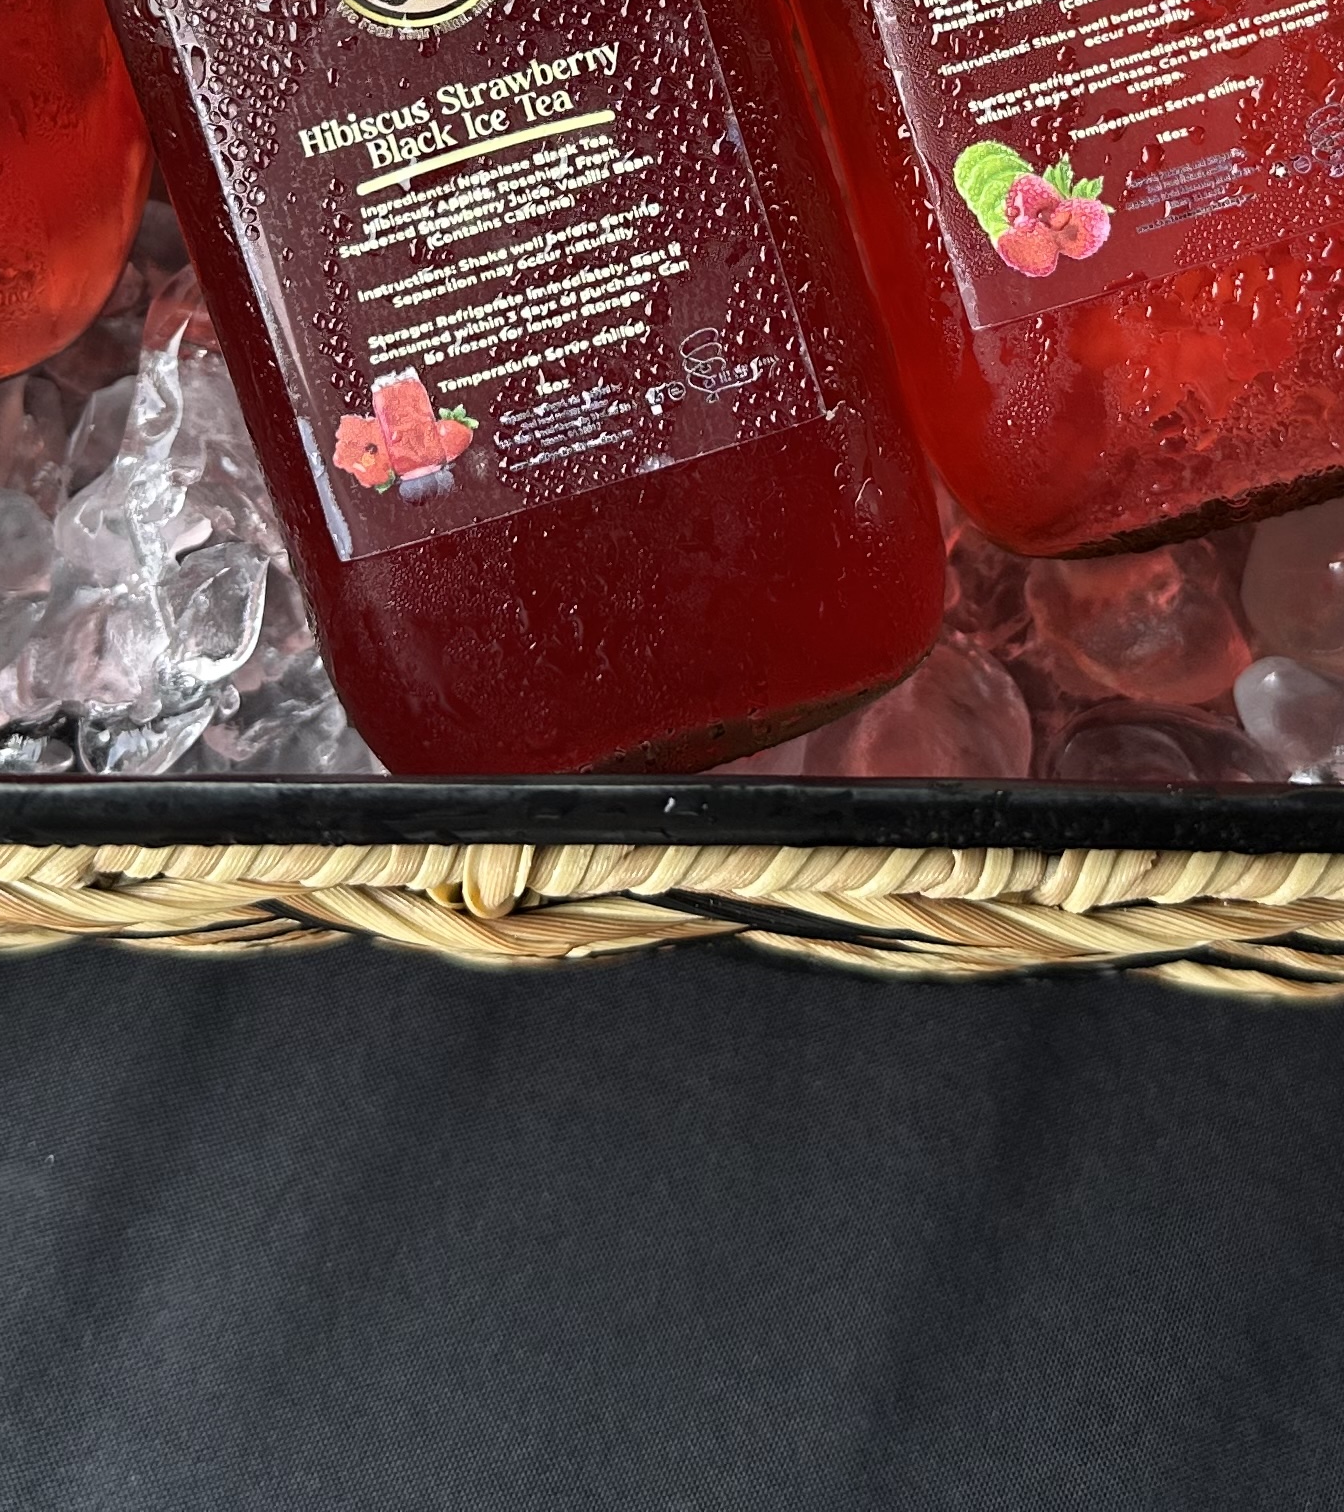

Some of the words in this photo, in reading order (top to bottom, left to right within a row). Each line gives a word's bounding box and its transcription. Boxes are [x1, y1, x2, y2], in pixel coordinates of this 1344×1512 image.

[933, 6, 1005, 37] Raspberry
[1084, 28, 1124, 47] occur
[1127, 8, 1194, 34] naturally.
[975, 105, 1021, 125] within
[1022, 100, 1033, 112] 3
[1034, 90, 1069, 108] days
[1070, 83, 1085, 97] of
[1158, 54, 1188, 69] Can
[1189, 48, 1209, 60] be
[1259, 25, 1281, 39] for
[1281, 10, 1329, 33] longer
[1127, 71, 1185, 94] storage.
[299, 99, 429, 157] Hibiscus
[437, 43, 618, 118] Strawberry
[366, 121, 456, 168] Black
[461, 108, 509, 139] Ice
[514, 84, 573, 121] Tea
[1069, 106, 1163, 141] Temperature:
[1164, 93, 1206, 112] Serve
[457, 160, 530, 189] Nepalese
[578, 134, 614, 151] Tea,
[1156, 127, 1189, 144] 16oz
[363, 202, 435, 235] Hibiscus,
[437, 187, 496, 213] Apples,
[575, 147, 620, 170] Fresh
[426, 217, 502, 250] (Contains
[504, 194, 575, 224] Caffeine)
[393, 275, 477, 308] Separation
[480, 263, 514, 282] may
[517, 247, 561, 270] occur
[565, 227, 638, 258] naturally.
[423, 350, 445, 365] be
[447, 335, 499, 357] frozen
[526, 310, 577, 333] longer
[580, 291, 644, 317] storage.
[535, 379, 571, 396] 16oz
